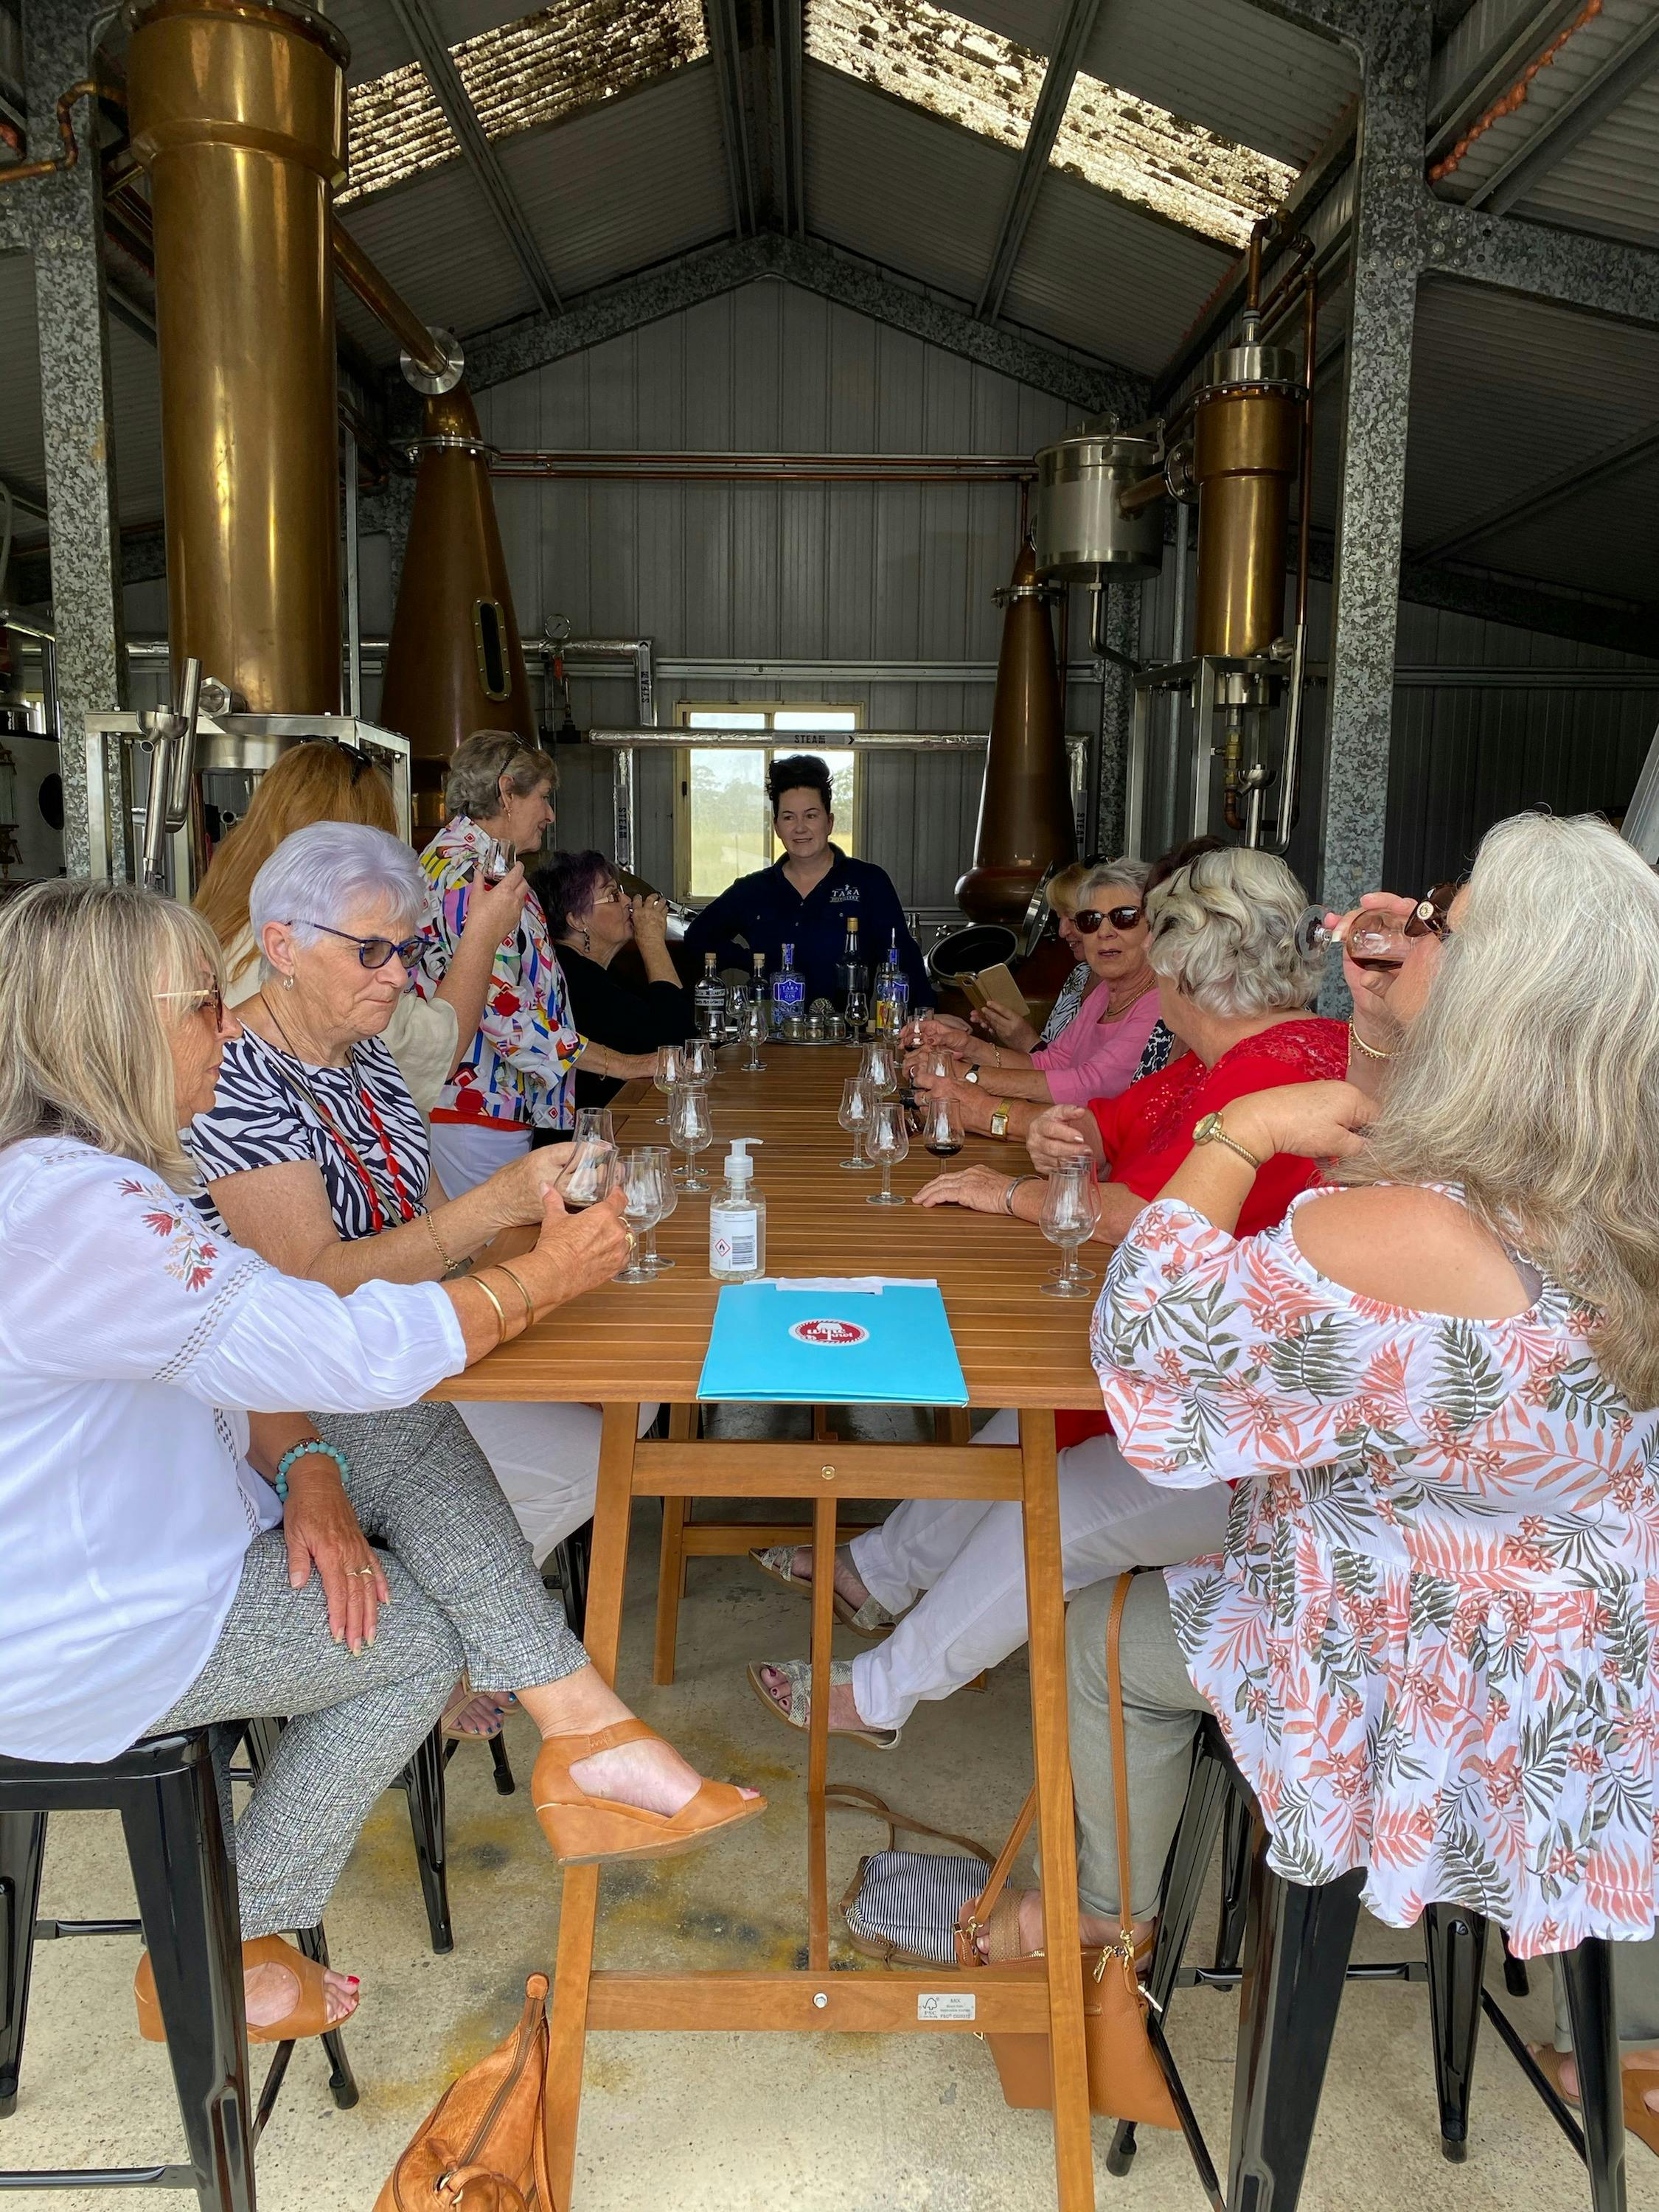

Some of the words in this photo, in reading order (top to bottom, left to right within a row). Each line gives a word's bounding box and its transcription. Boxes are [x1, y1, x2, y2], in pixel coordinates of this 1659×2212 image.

[794, 734, 826, 744] STEAM
[619, 807, 627, 839] STEAM
[1076, 813, 1085, 844] STEAM
